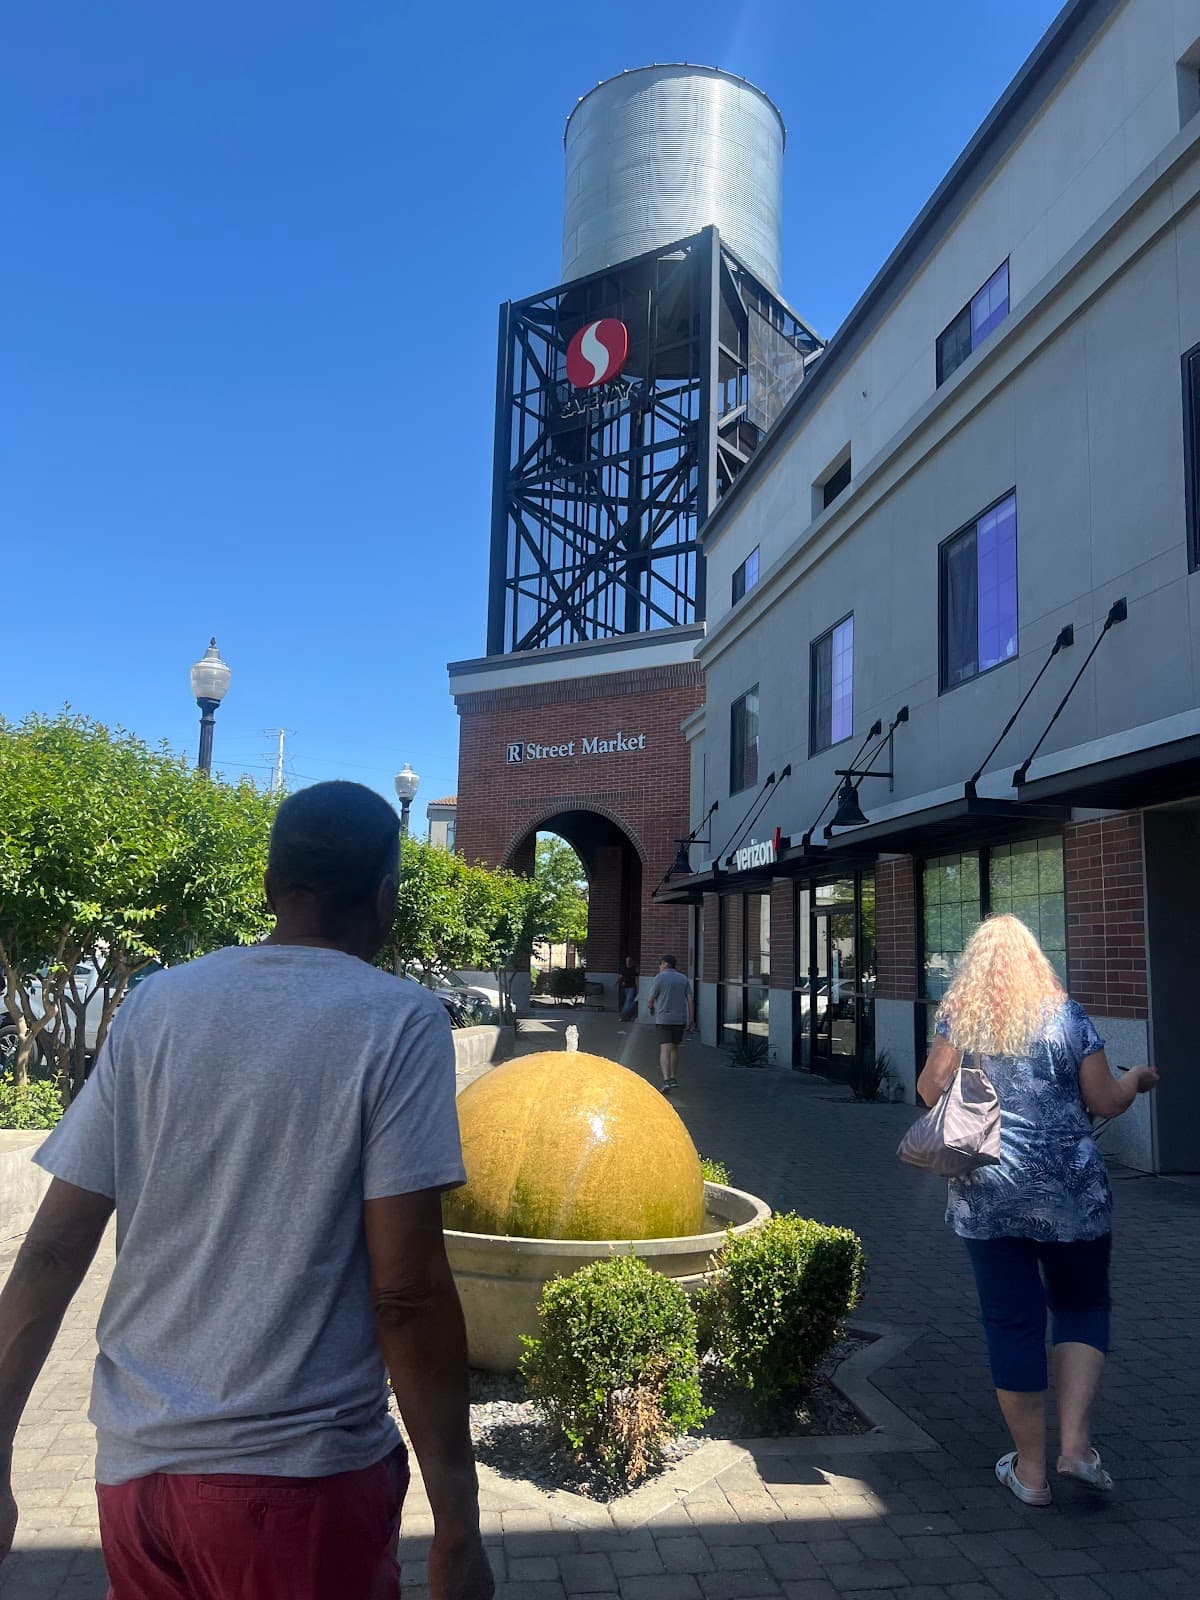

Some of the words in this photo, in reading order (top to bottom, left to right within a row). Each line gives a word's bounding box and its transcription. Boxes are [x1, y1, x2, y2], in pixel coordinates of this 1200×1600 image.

[507, 744, 522, 763] R
[526, 741, 575, 760] Street
[581, 732, 646, 755] Market
[736, 839, 774, 871] verizon
